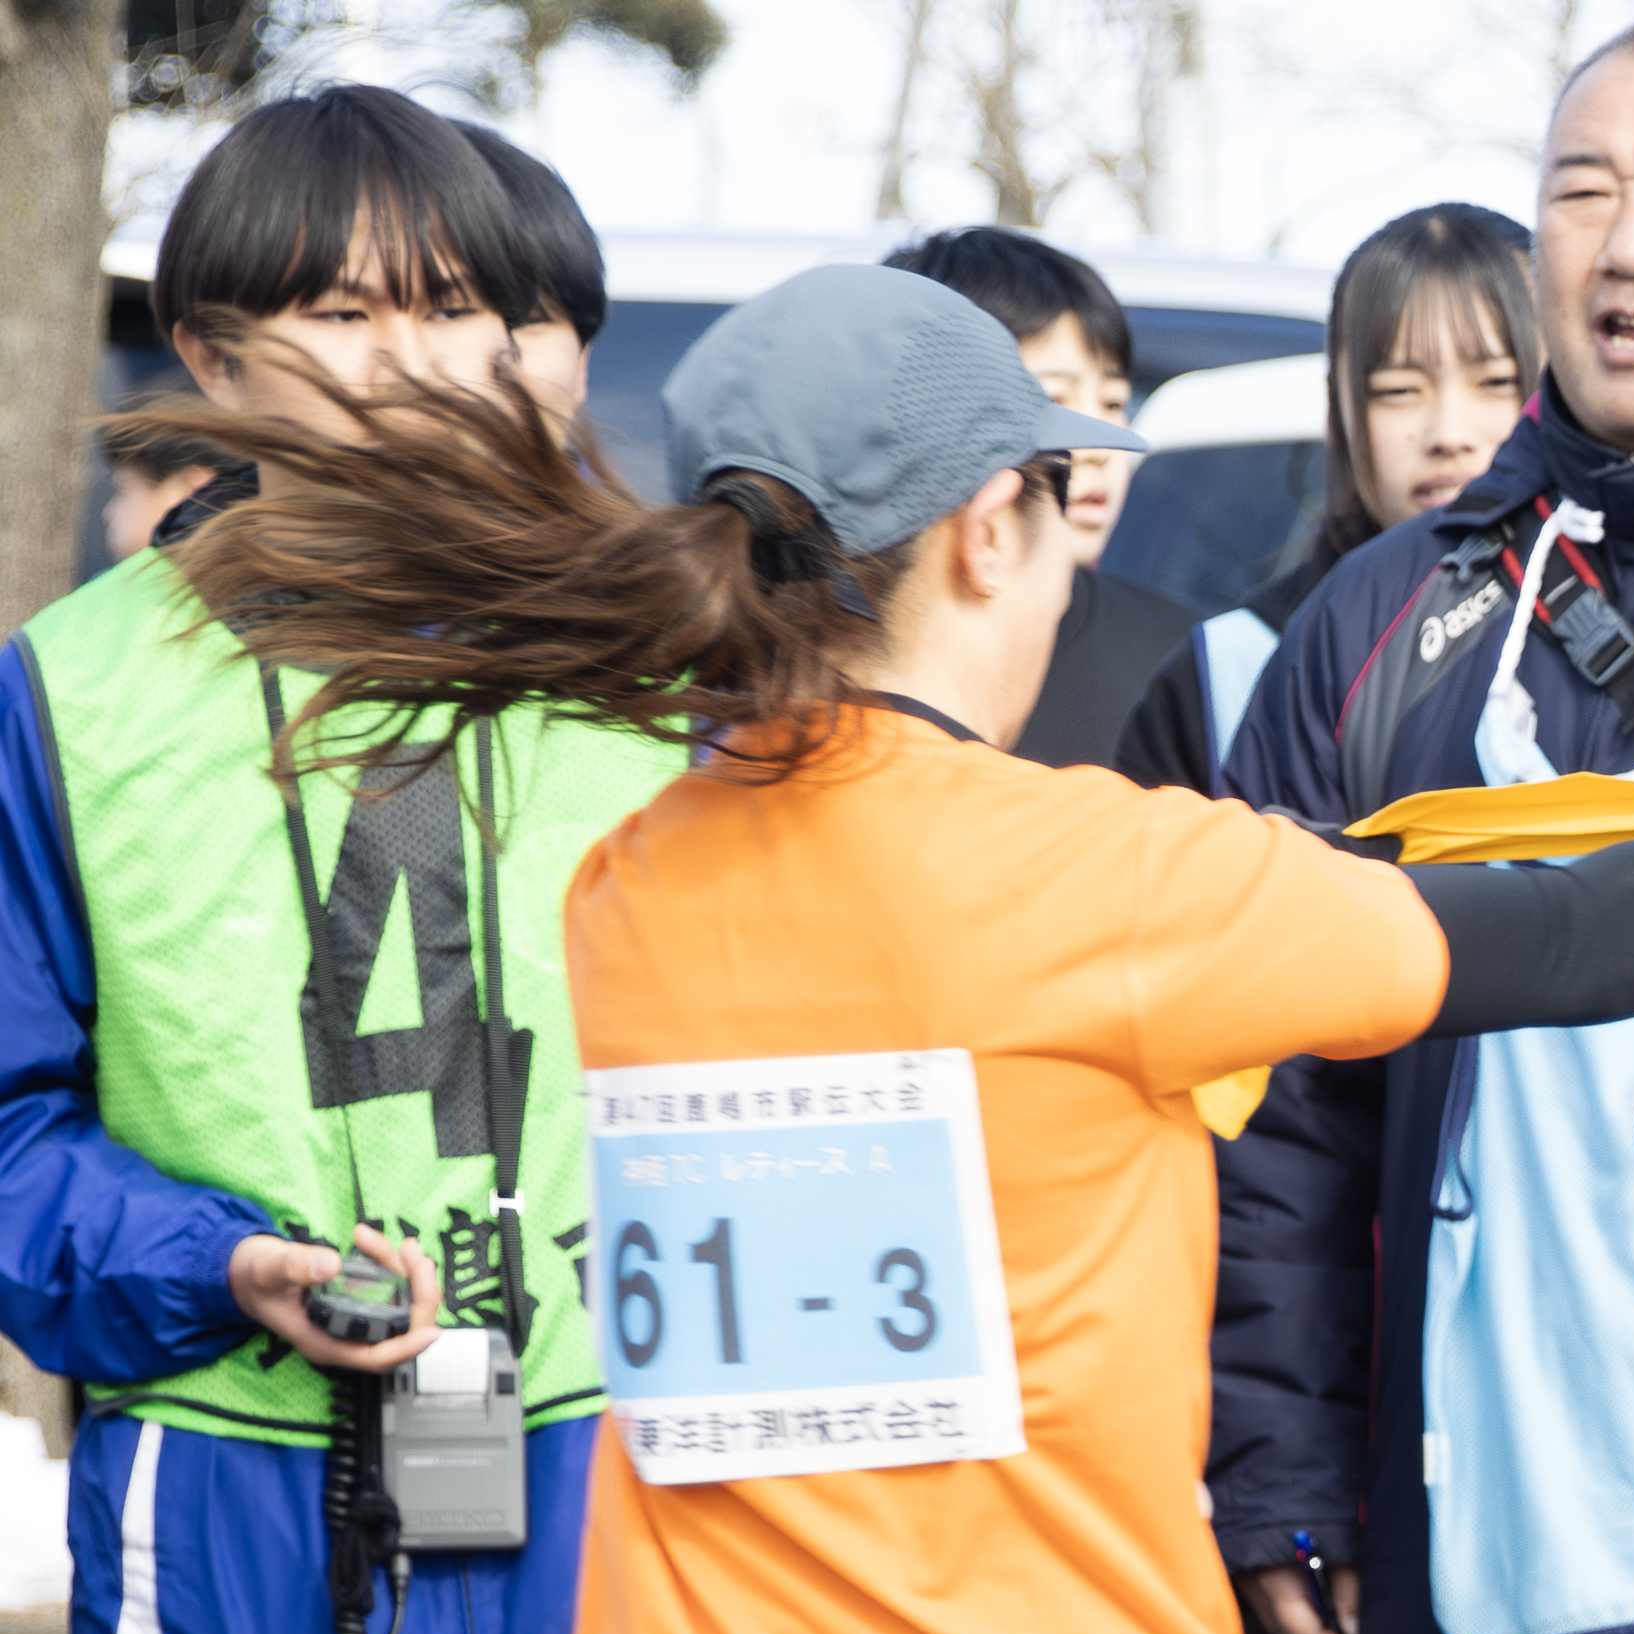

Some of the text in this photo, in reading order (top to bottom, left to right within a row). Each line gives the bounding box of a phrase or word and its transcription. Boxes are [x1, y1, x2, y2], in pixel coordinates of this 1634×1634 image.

[300, 742, 505, 1158] 4
[614, 1216, 745, 1368] 61
[875, 1247, 940, 1352] 3
